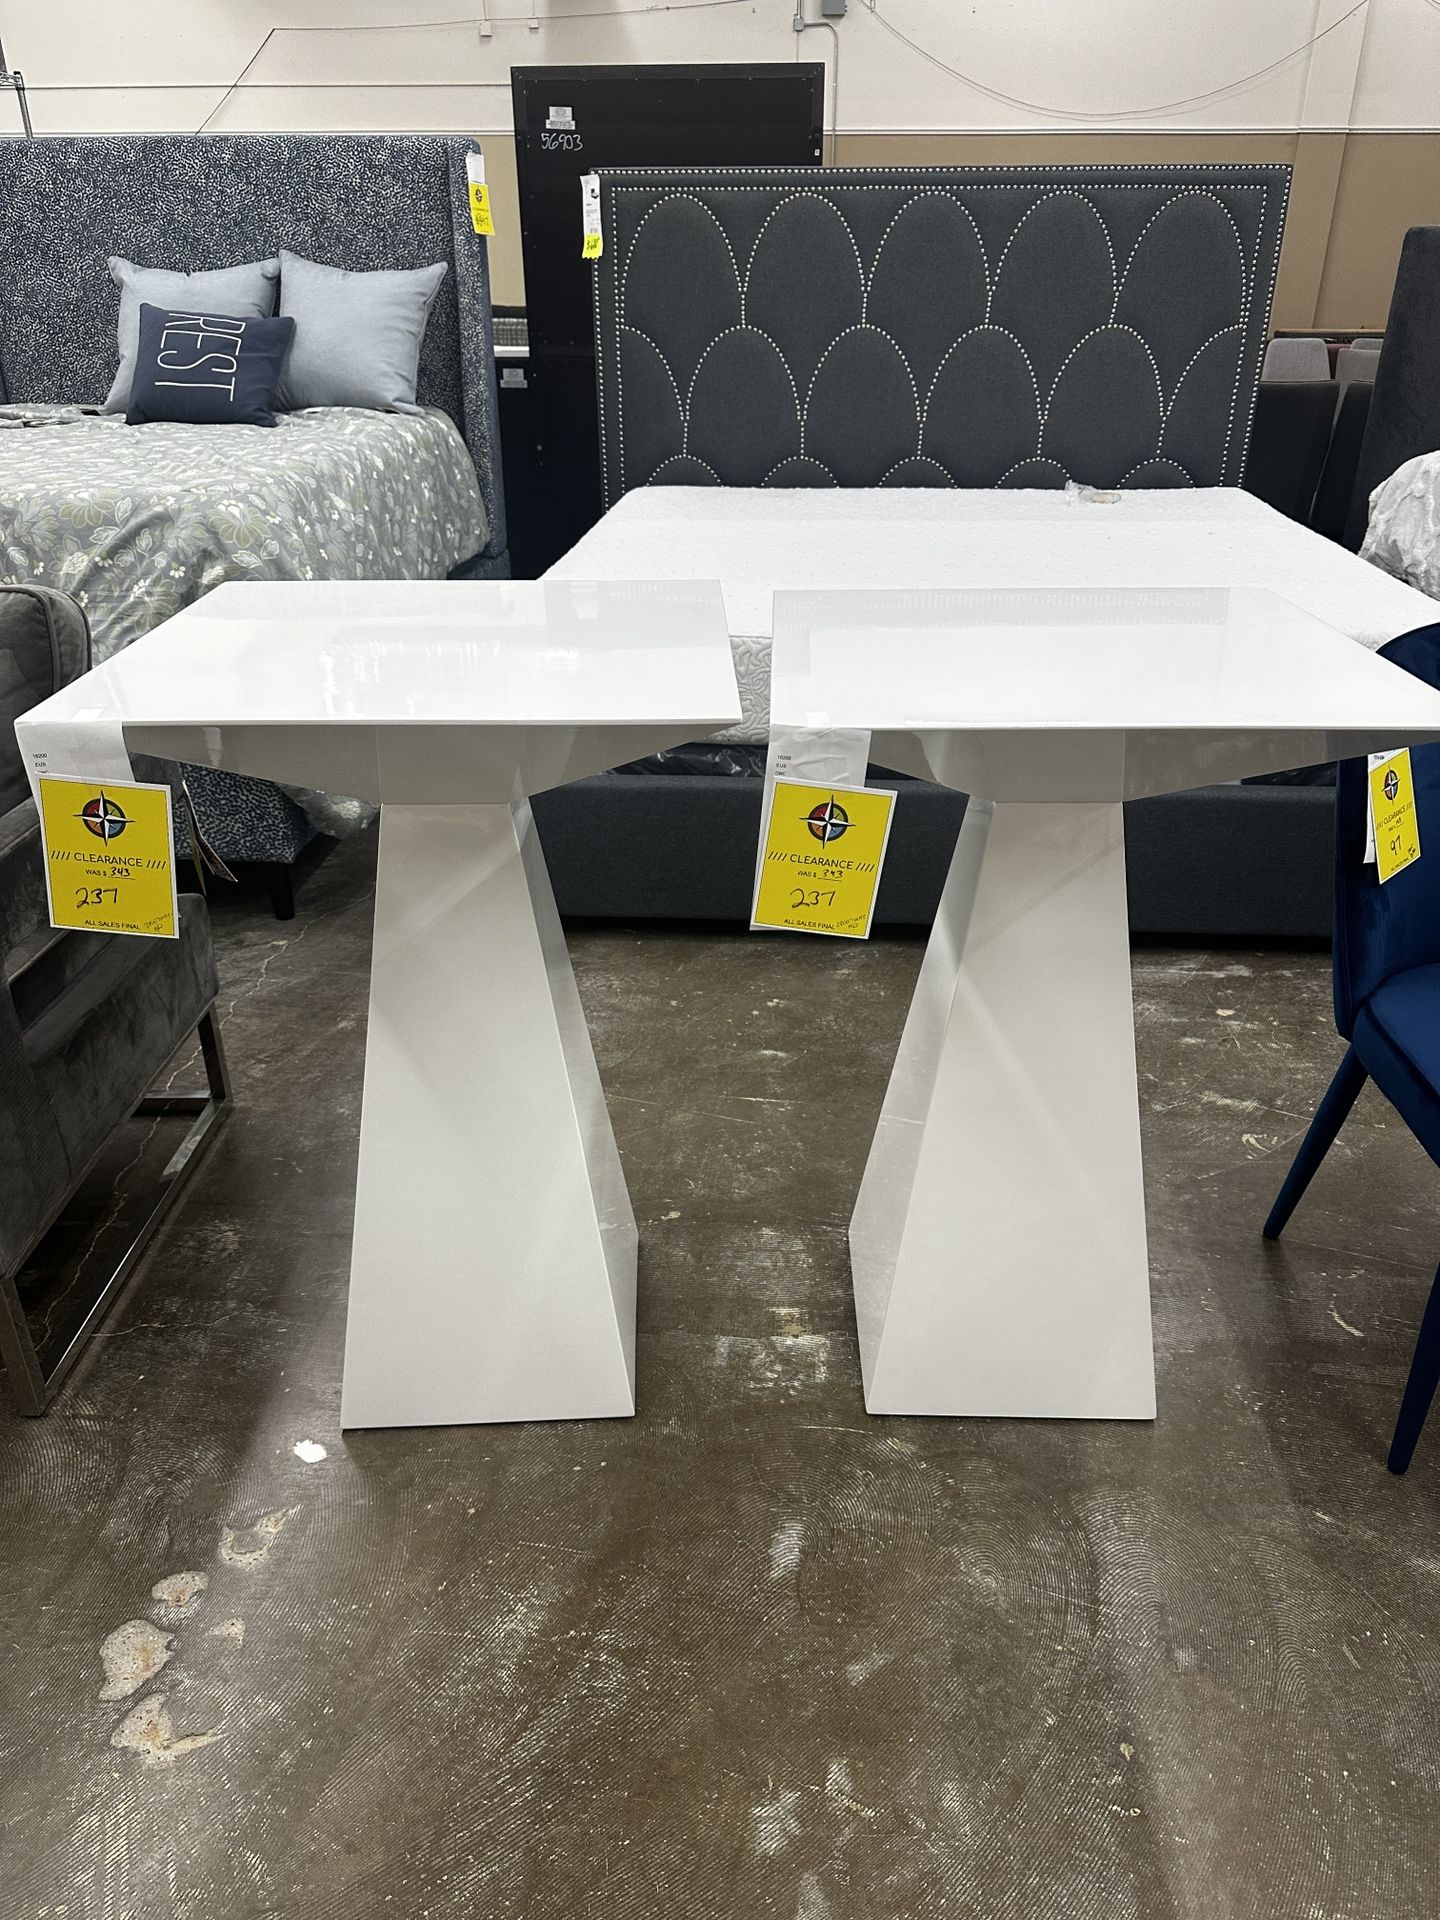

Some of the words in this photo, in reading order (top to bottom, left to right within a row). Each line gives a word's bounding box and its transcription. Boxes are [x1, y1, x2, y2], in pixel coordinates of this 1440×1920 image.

[541, 132, 583, 151] 56903
[154, 312, 246, 402] REST
[73, 852, 144, 868] CLEARANCE
[789, 853, 854, 870] CLEARANCE
[85, 868, 102, 877] WAS
[110, 866, 131, 877] 343
[797, 870, 812, 878] WAS
[98, 921, 121, 929] SALES
[121, 922, 140, 930] FINAL
[796, 920, 817, 928] SALES
[817, 922, 836, 930] FINAL
